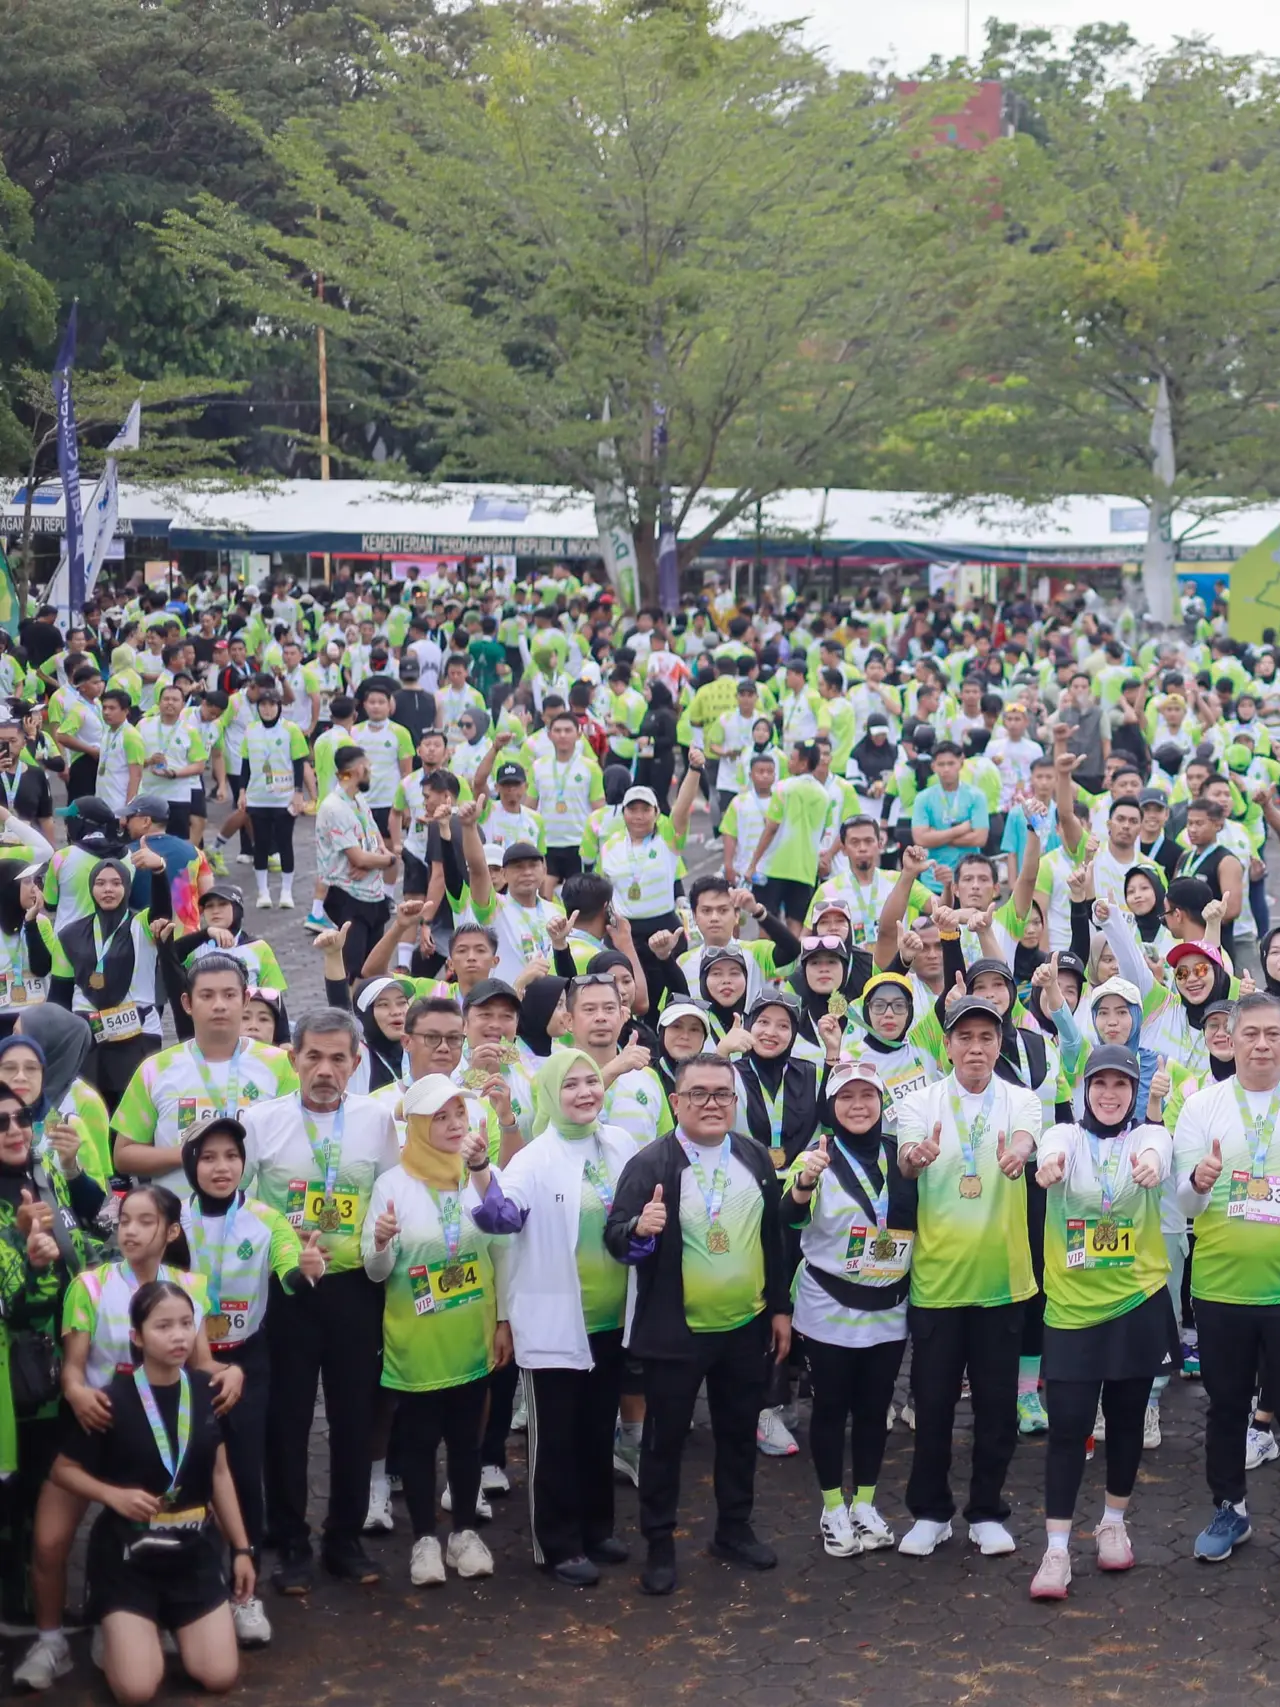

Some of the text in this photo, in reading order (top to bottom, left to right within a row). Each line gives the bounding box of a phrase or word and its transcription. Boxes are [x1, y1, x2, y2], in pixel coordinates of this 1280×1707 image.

[114, 519, 134, 533] ESIA
[362, 535, 433, 551] KEMENTERIAN
[436, 536, 513, 553] PERDAGANGAN
[515, 538, 565, 554] REPUBLIK
[106, 1010, 137, 1028] 5408
[893, 1076, 927, 1099] 5377
[312, 1197, 353, 1219] 03
[1229, 1203, 1245, 1214] 10K
[846, 1260, 860, 1270] 5K
[1068, 1252, 1084, 1265] VIP
[438, 1266, 477, 1294] 04
[415, 1297, 433, 1313] VIP
